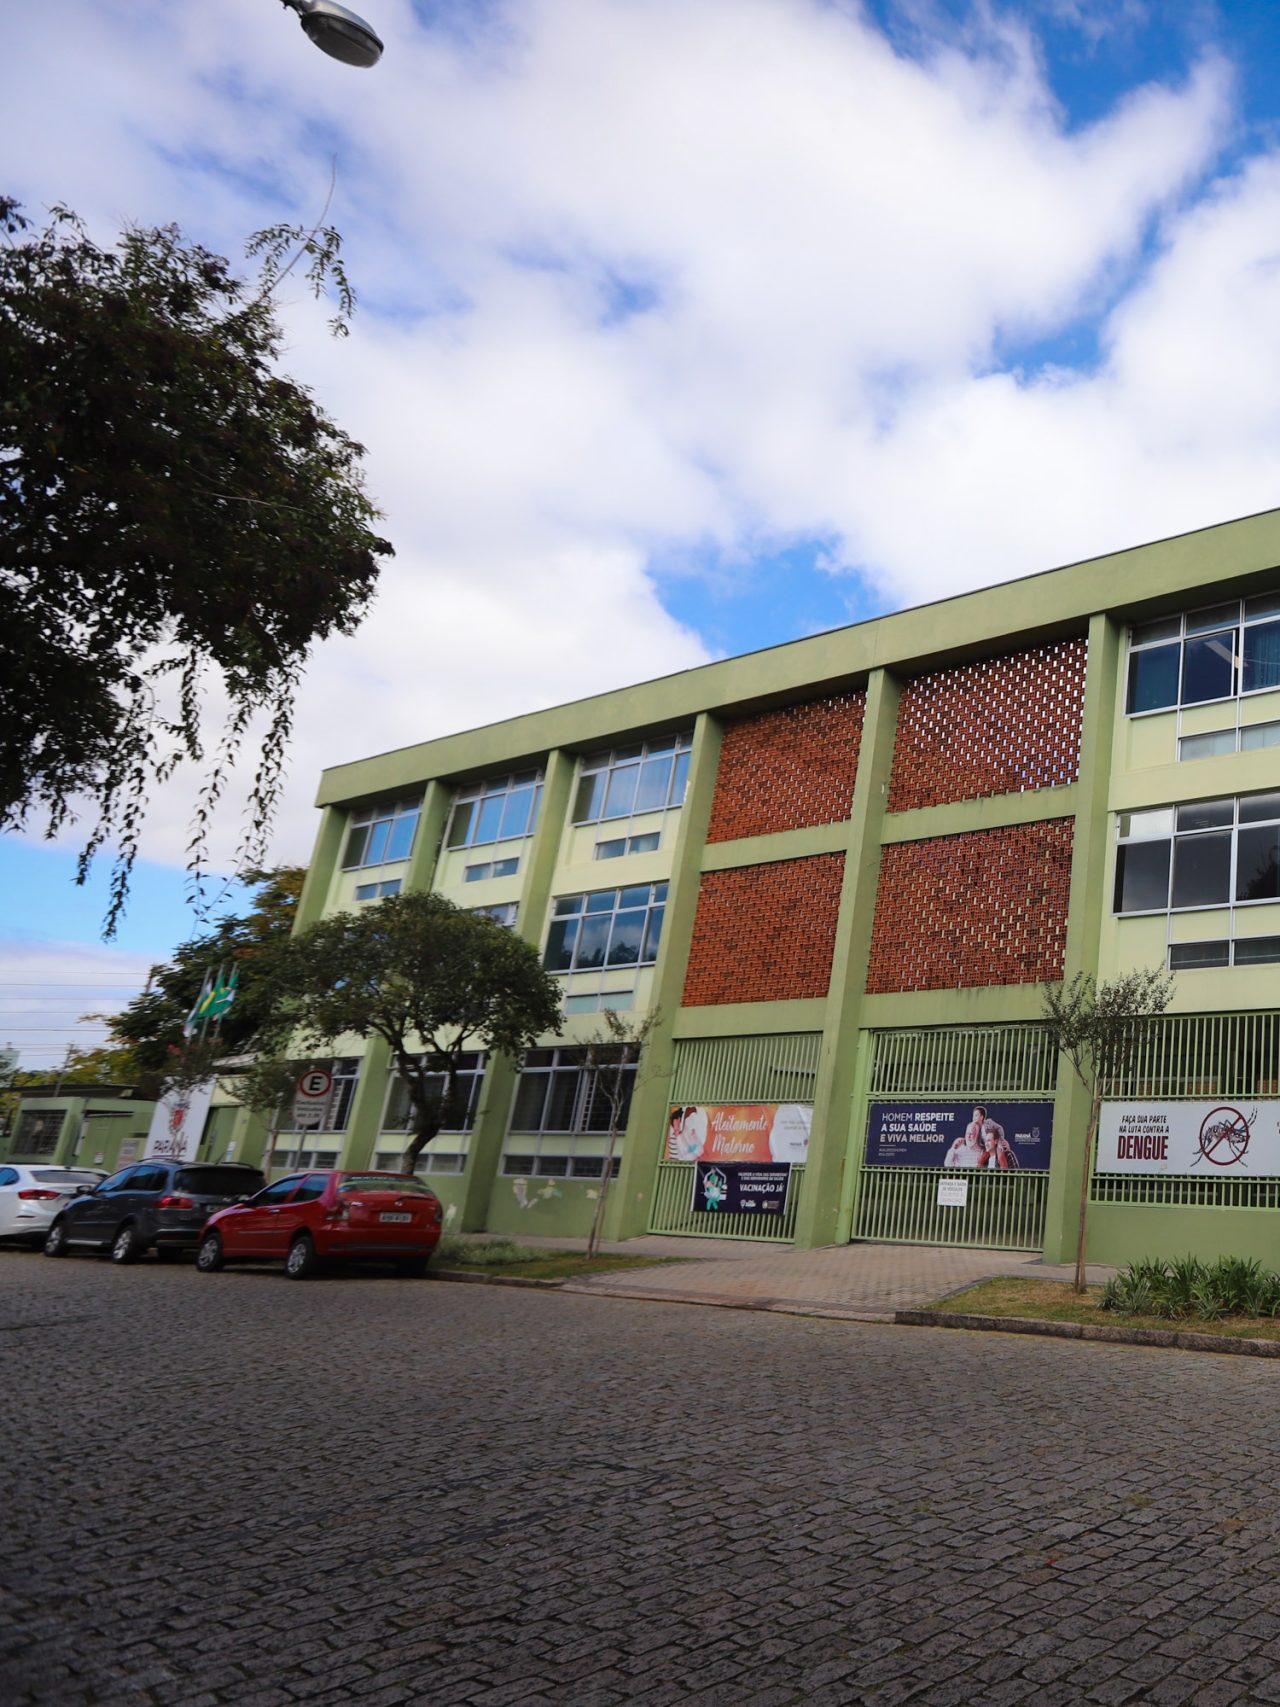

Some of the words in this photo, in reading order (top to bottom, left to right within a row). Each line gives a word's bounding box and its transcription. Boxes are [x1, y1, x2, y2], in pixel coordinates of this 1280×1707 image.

[309, 1075, 323, 1091] E
[711, 1110, 768, 1132] Aleitamento
[881, 1112, 913, 1122] HOMEM
[914, 1112, 955, 1122] RESPEITE
[1122, 1114, 1136, 1125] FAÇA
[1137, 1114, 1148, 1123] SUA
[1149, 1115, 1167, 1123] PARTE
[880, 1123, 888, 1132] A
[889, 1123, 907, 1132] SUA
[908, 1120, 937, 1132] SAÚDE
[1119, 1125, 1127, 1133] NA
[1128, 1125, 1142, 1133] LUTA
[1142, 1125, 1164, 1133] CONTRA
[1164, 1125, 1170, 1133] A
[712, 1133, 755, 1156] Materno
[880, 1134, 886, 1143] E
[887, 1134, 908, 1143] VIVA
[910, 1134, 945, 1143] MELHOR
[1117, 1135, 1169, 1160] DENGUE
[740, 1182, 776, 1194] VACINAÇÃO
[776, 1182, 784, 1192] JÁ
